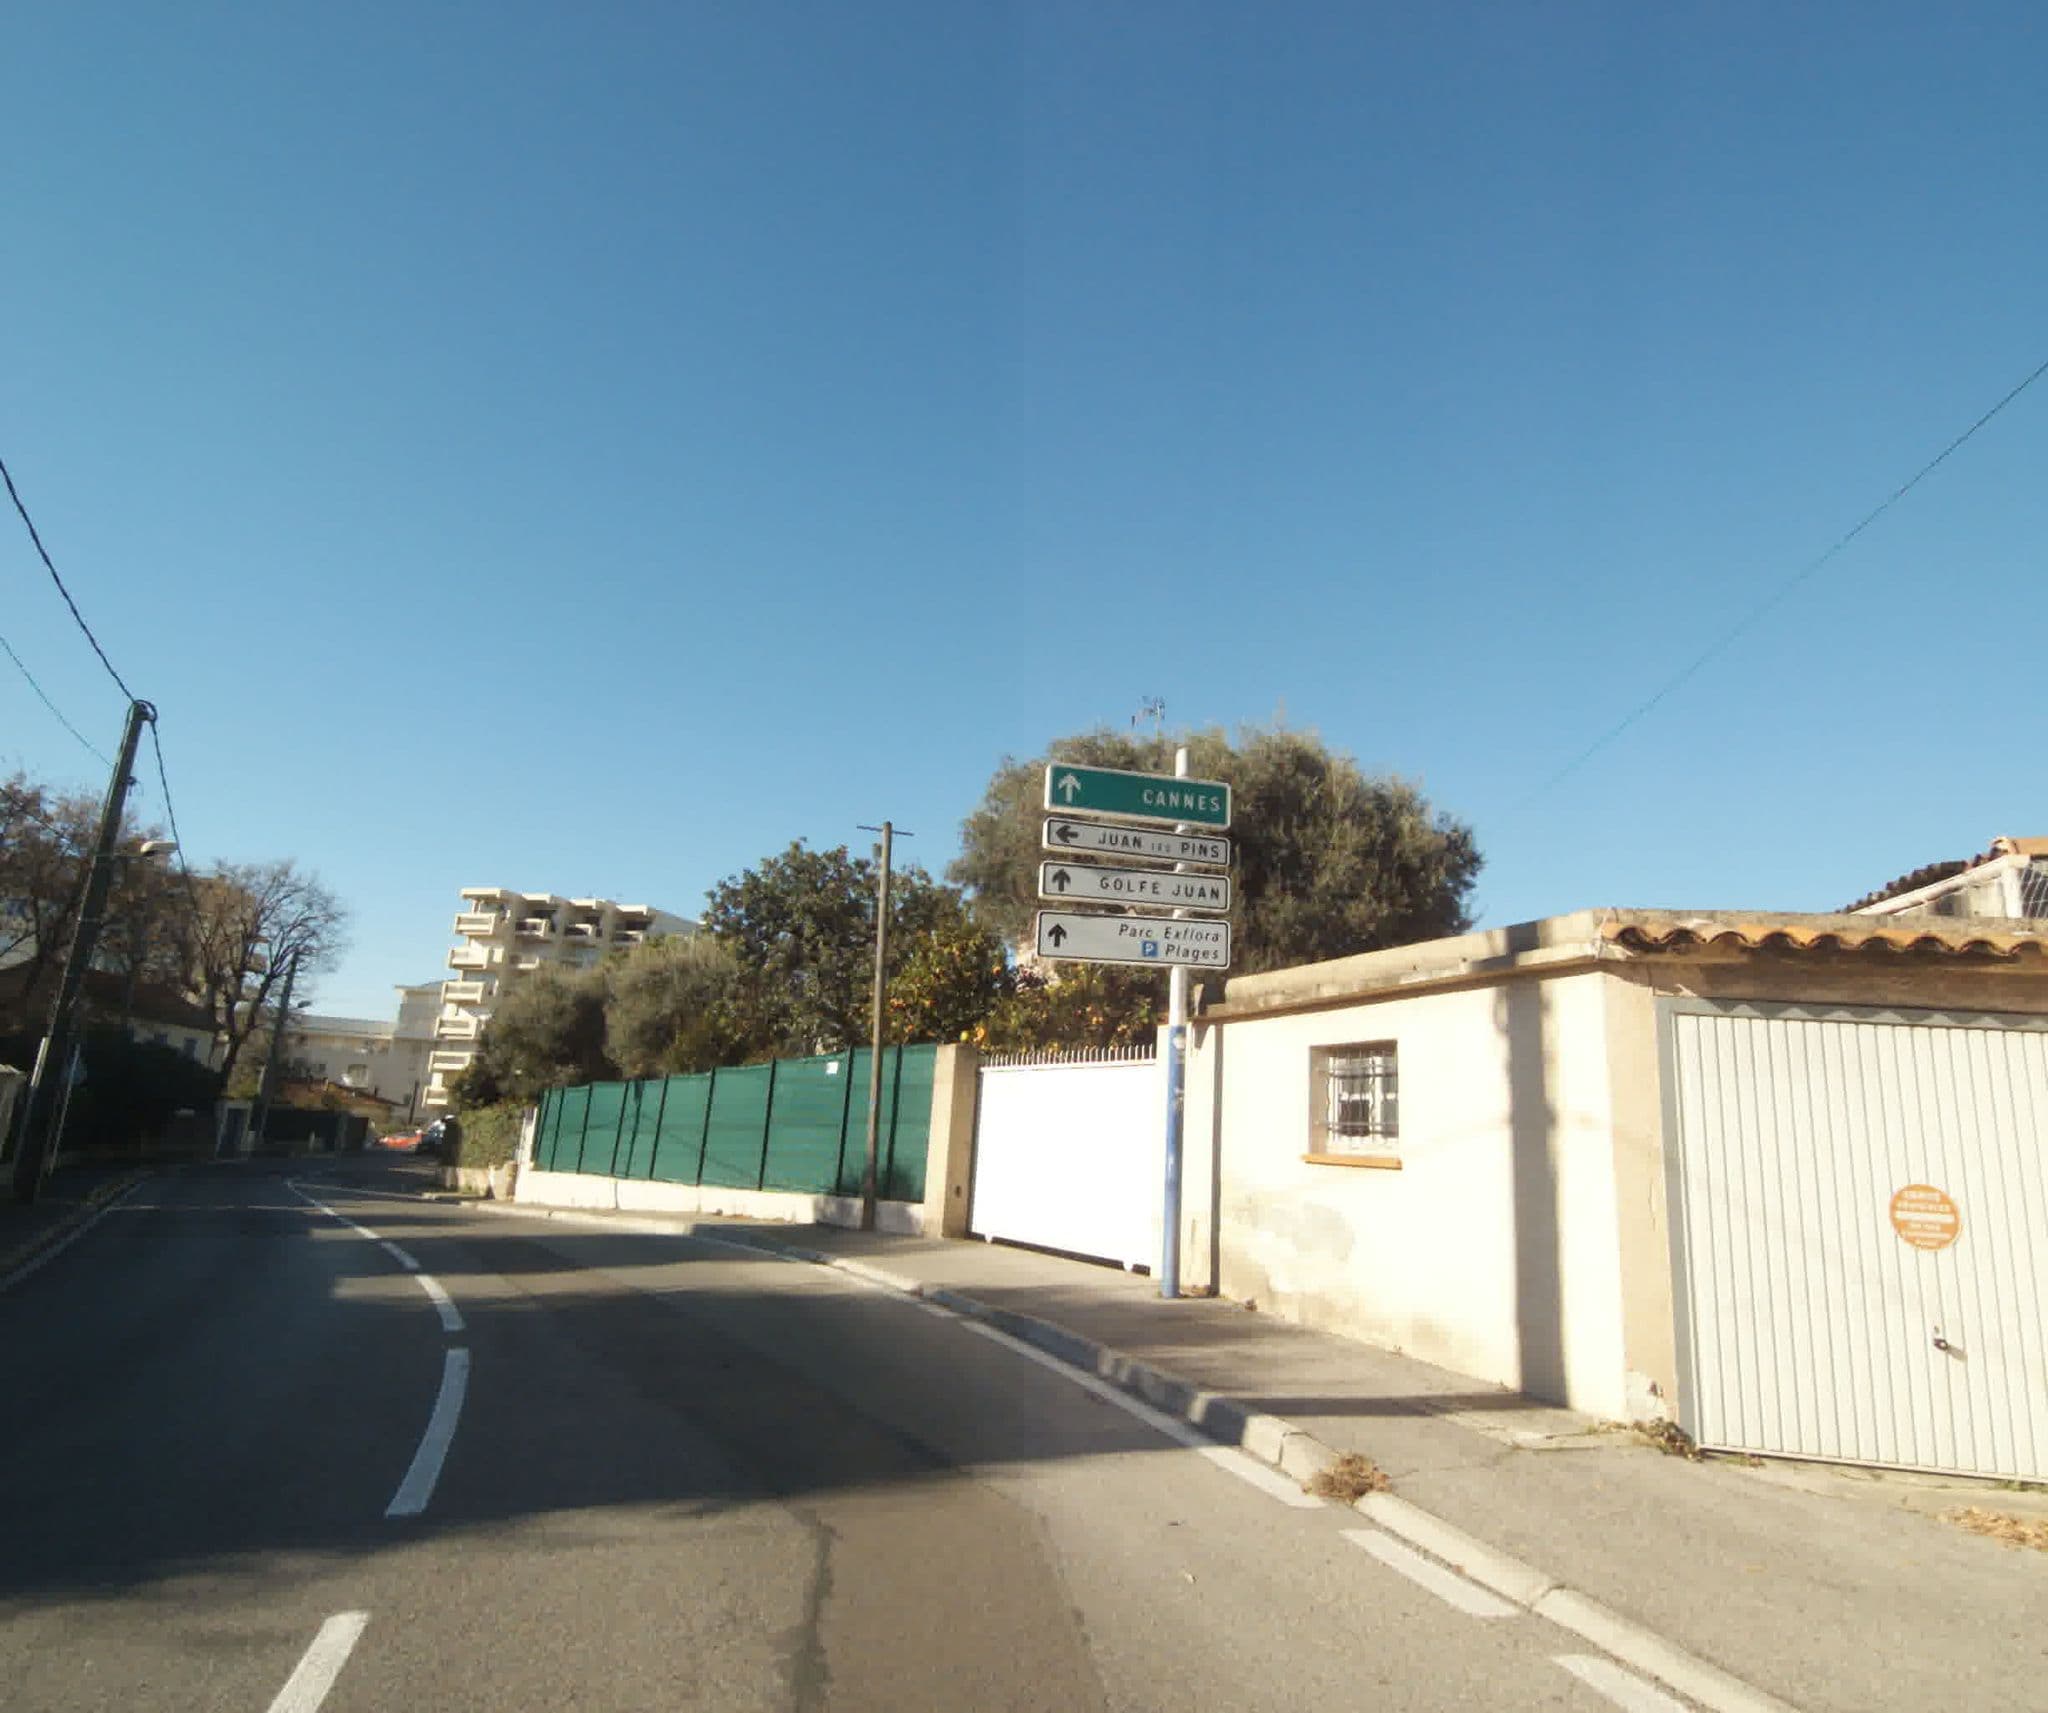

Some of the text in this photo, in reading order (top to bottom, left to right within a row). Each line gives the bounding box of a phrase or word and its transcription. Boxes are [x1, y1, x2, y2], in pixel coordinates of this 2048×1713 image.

[1143, 790, 1221, 812] CANNES
[1098, 832, 1142, 849] JUAN
[1181, 842, 1219, 858] PINS
[1100, 876, 1220, 900] GOLFE JUAN
[1118, 923, 1220, 942] Parc Exflora
[1165, 943, 1219, 962] Plages
